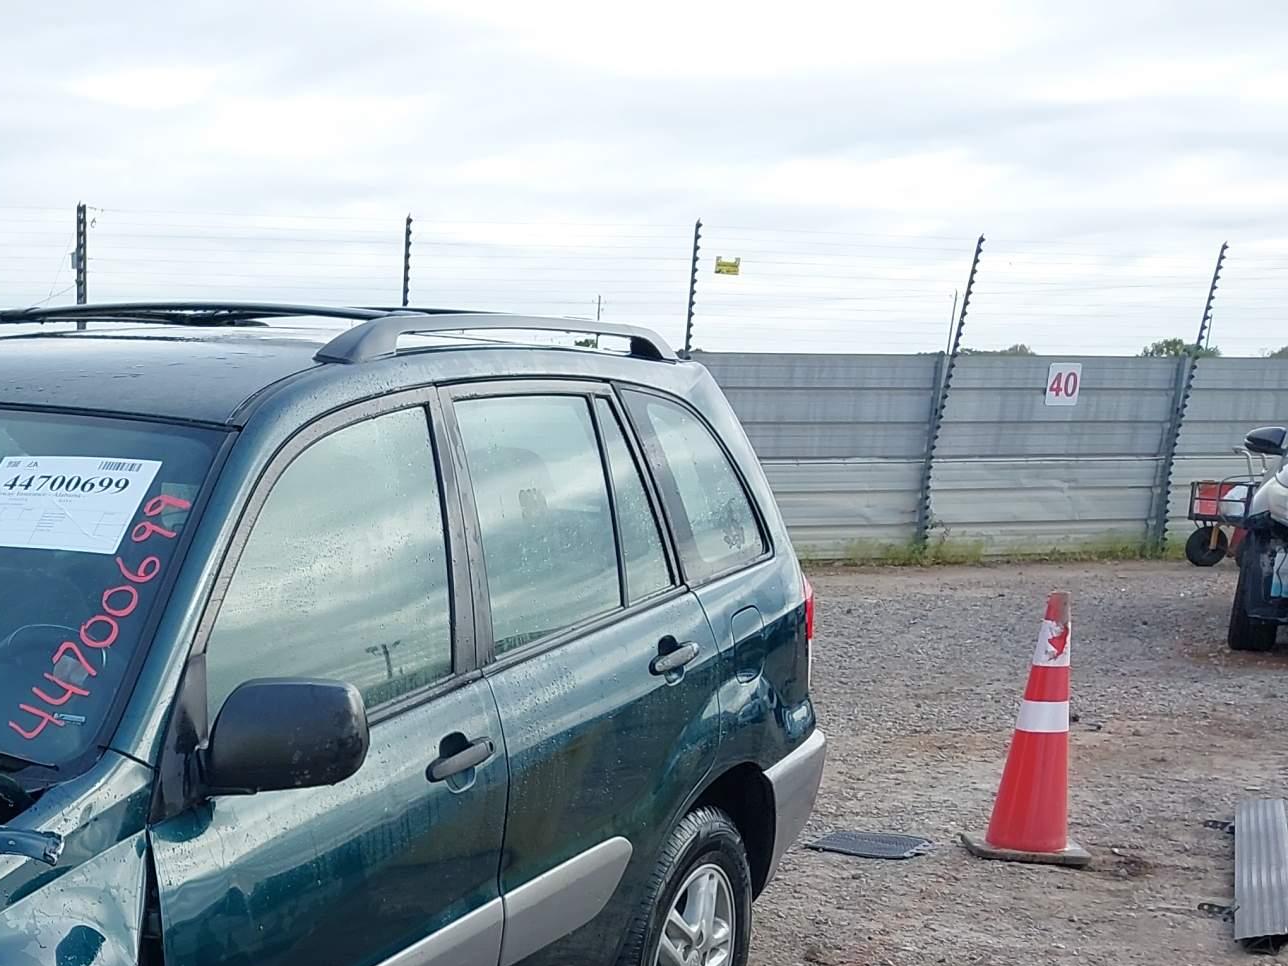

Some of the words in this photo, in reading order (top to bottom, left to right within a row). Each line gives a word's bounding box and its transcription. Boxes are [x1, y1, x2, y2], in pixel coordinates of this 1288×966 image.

[1048, 371, 1078, 397] 40
[3, 475, 130, 495] 44700699
[9, 495, 191, 739] 44700699
